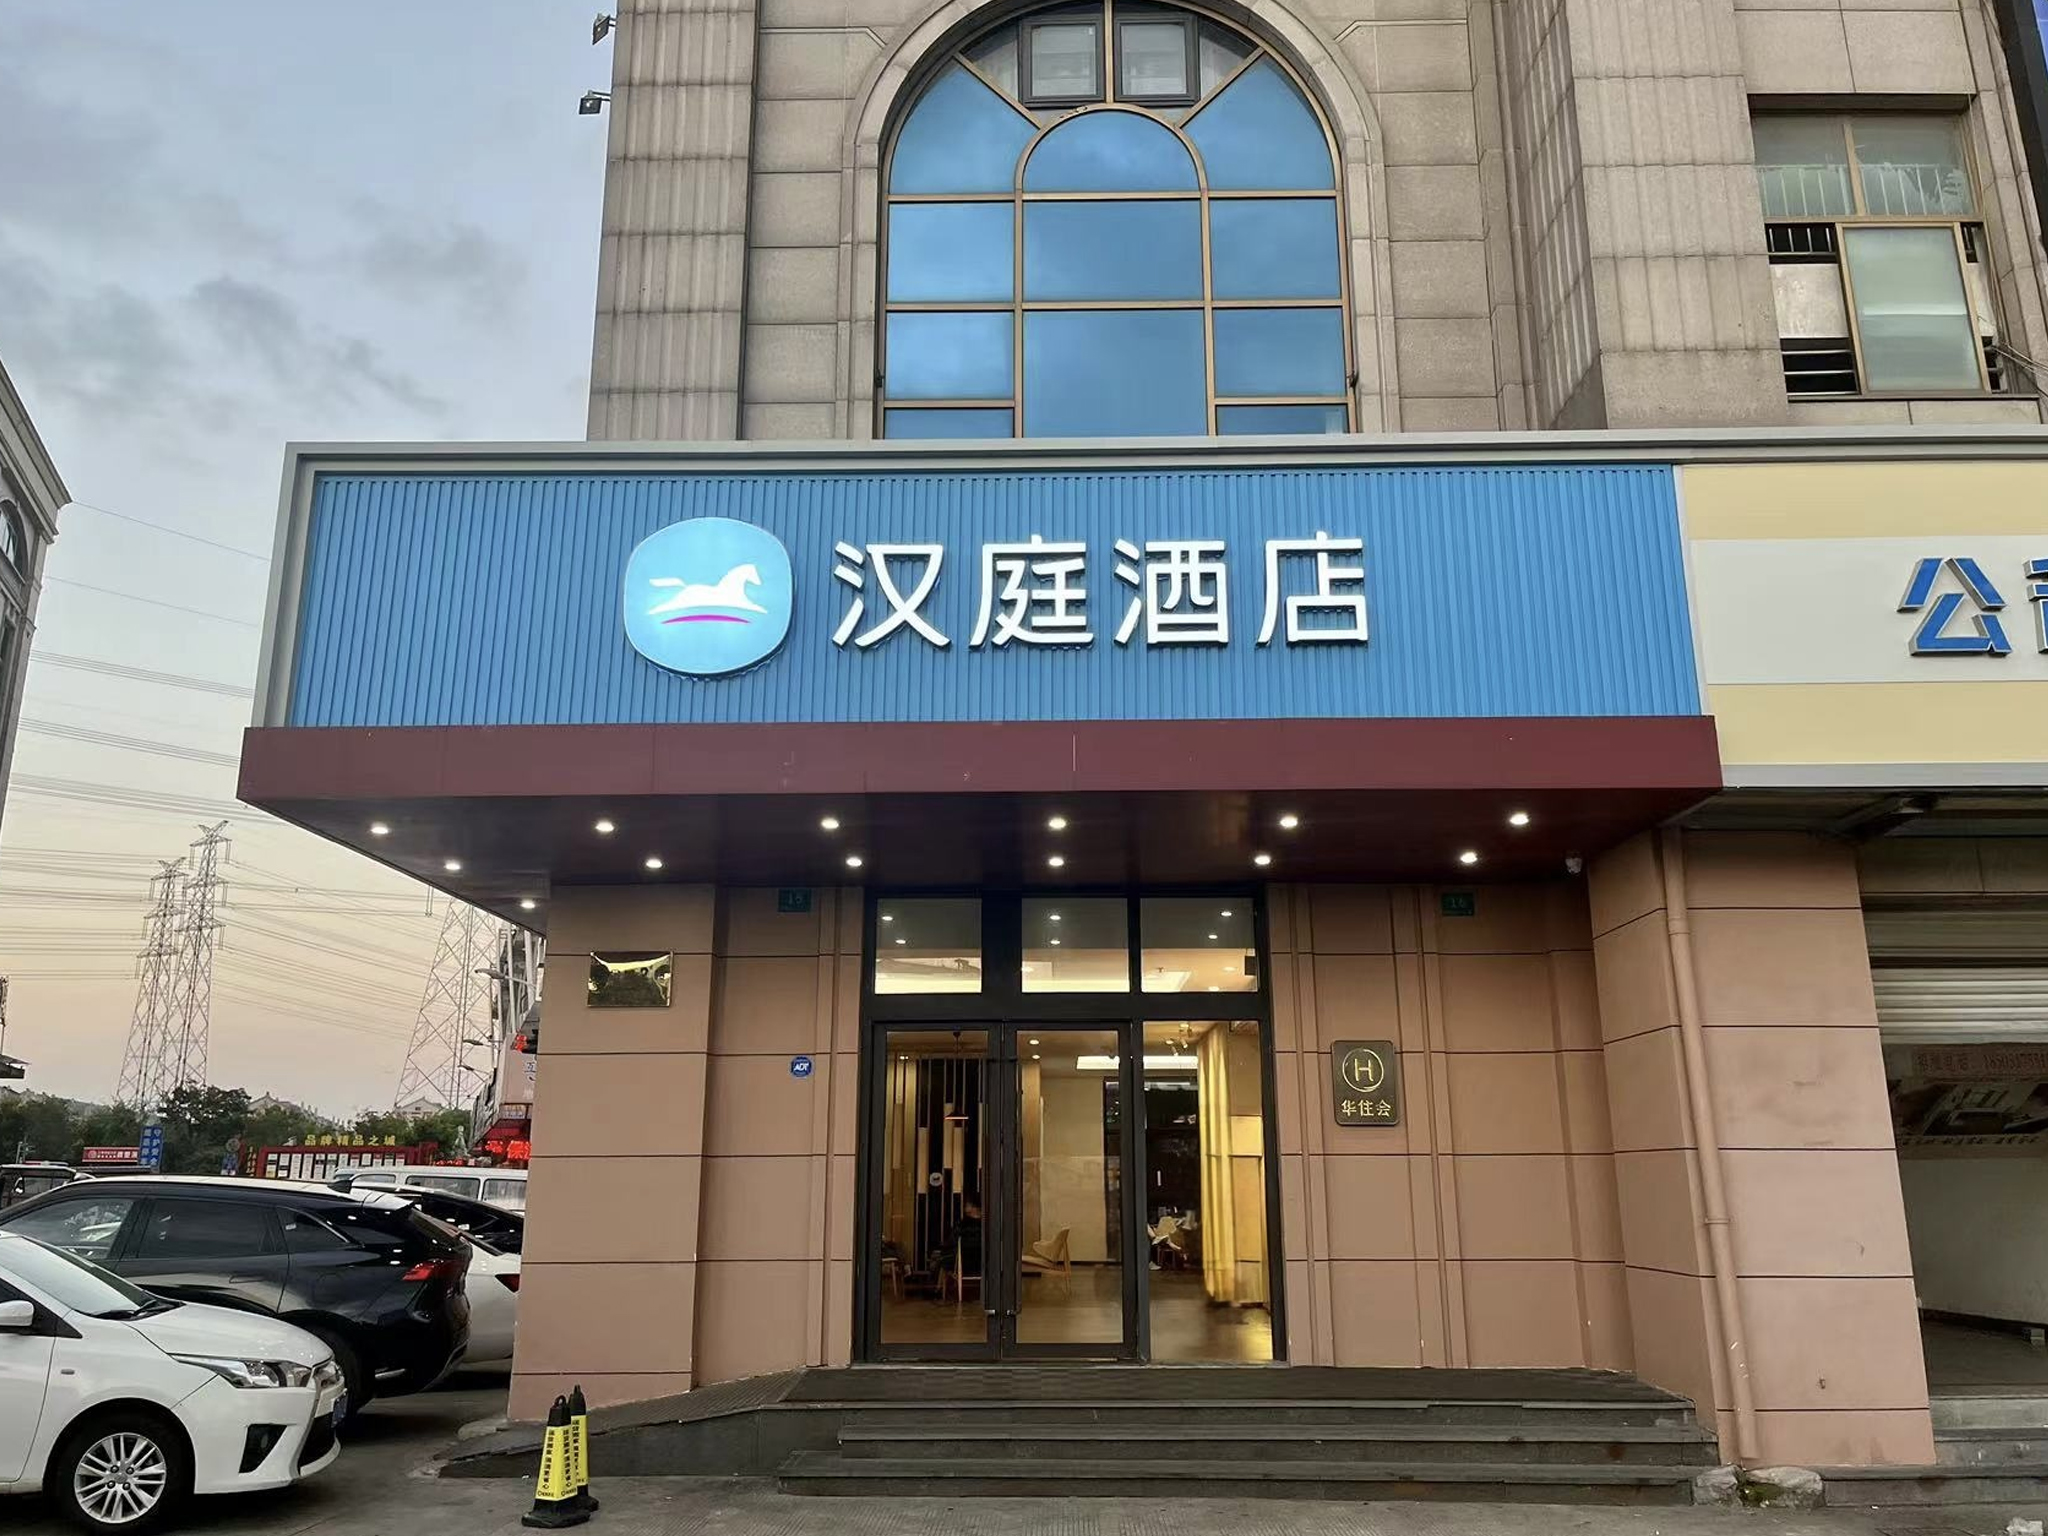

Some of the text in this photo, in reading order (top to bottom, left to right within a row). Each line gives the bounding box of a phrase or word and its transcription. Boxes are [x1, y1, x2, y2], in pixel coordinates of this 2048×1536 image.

[832, 531, 1368, 650] 汉庭酒店
[1898, 556, 2048, 656] 公
[1341, 1099, 1392, 1118] 华住会
[304, 1134, 396, 1147] 品牌精品之城
